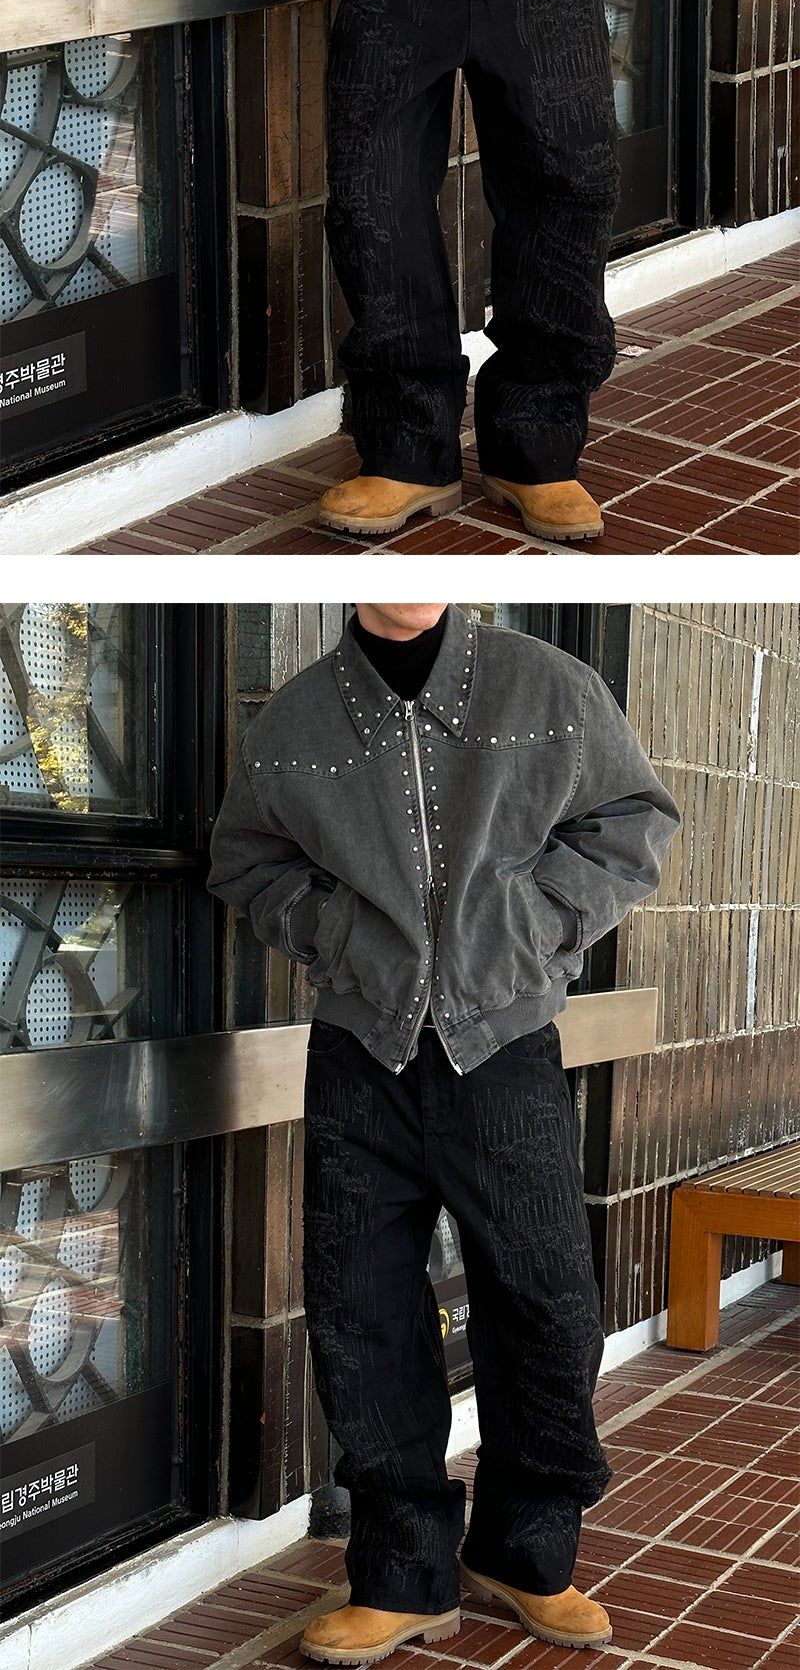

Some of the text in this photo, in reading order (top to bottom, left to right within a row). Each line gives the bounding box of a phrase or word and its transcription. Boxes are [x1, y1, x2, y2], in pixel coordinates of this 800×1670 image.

[0, 379, 66, 408] National Museum
[1, 1463, 79, 1514] 립경주박물관
[22, 1500, 51, 1520] National
[51, 1490, 79, 1508] Museum
